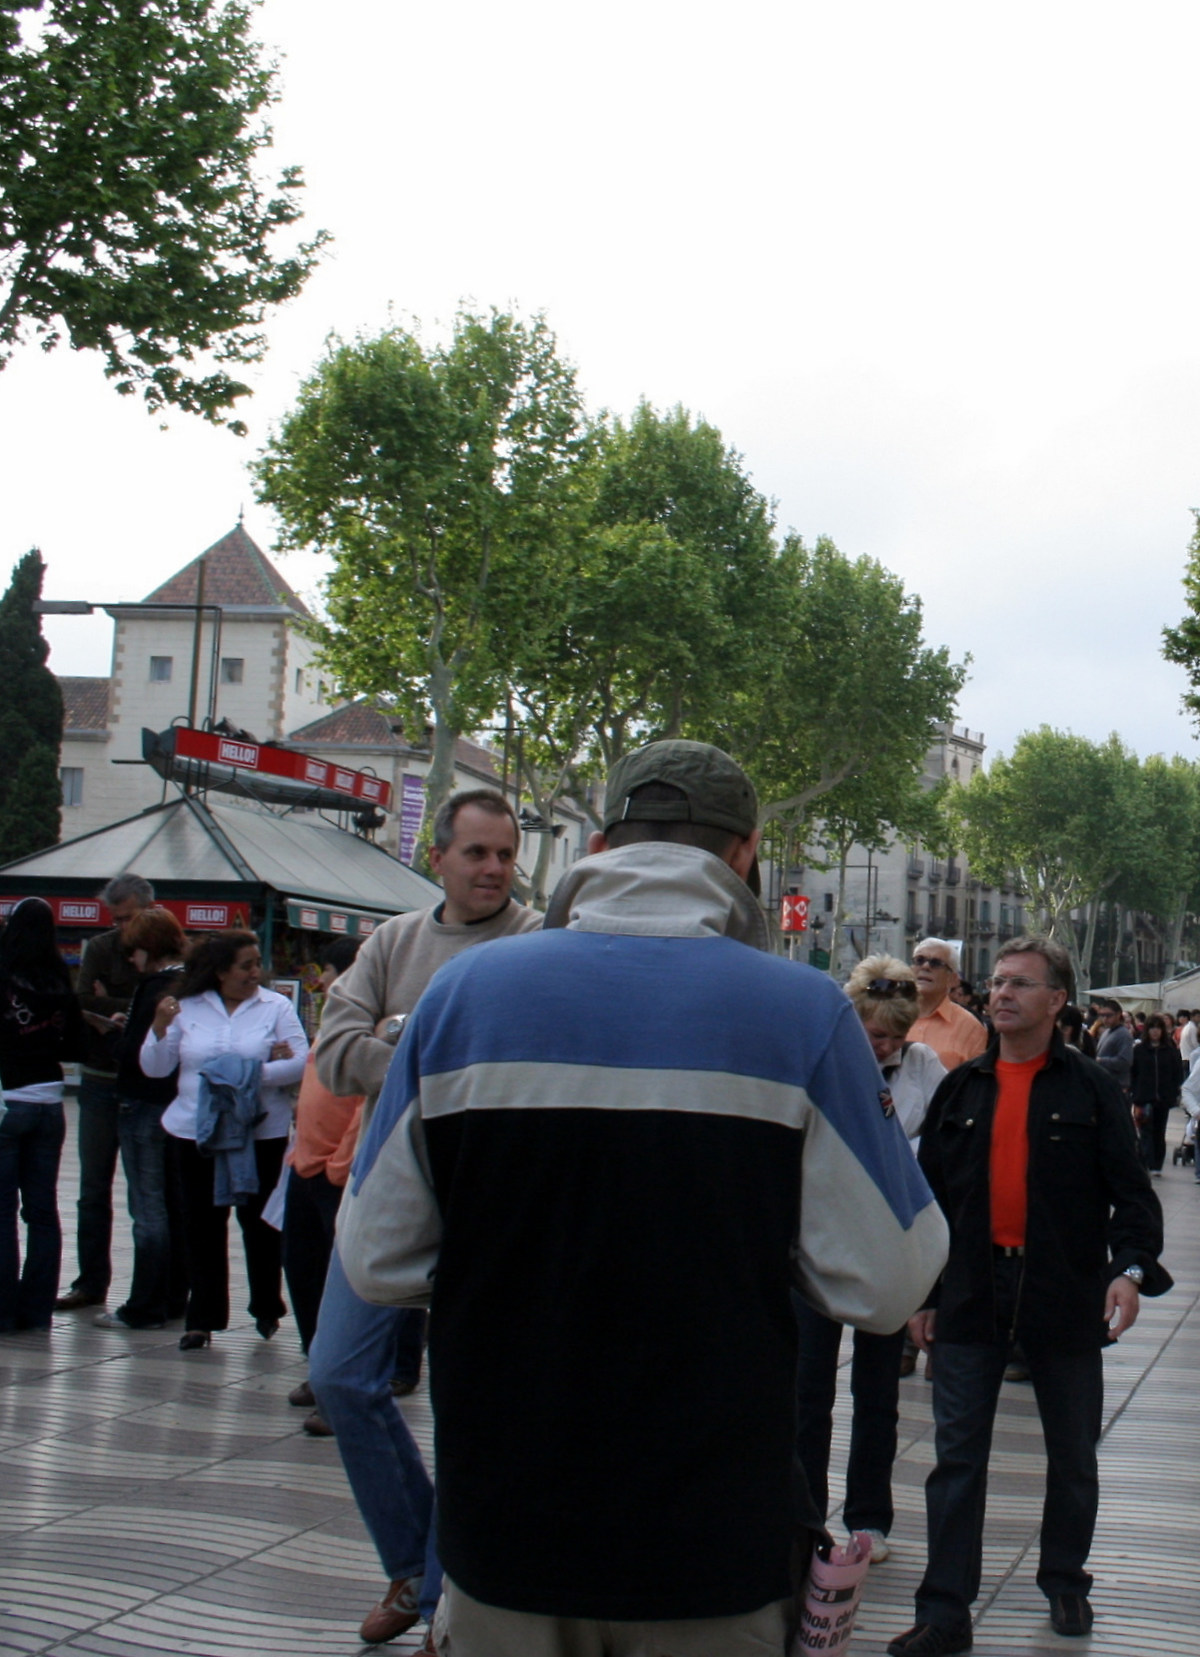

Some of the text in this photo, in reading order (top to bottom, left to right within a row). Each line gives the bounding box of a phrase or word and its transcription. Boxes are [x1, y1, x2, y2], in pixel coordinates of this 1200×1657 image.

[222, 742, 256, 763] HELLO!
[62, 905, 96, 919] HELLO!
[189, 908, 224, 922] HELLO!
